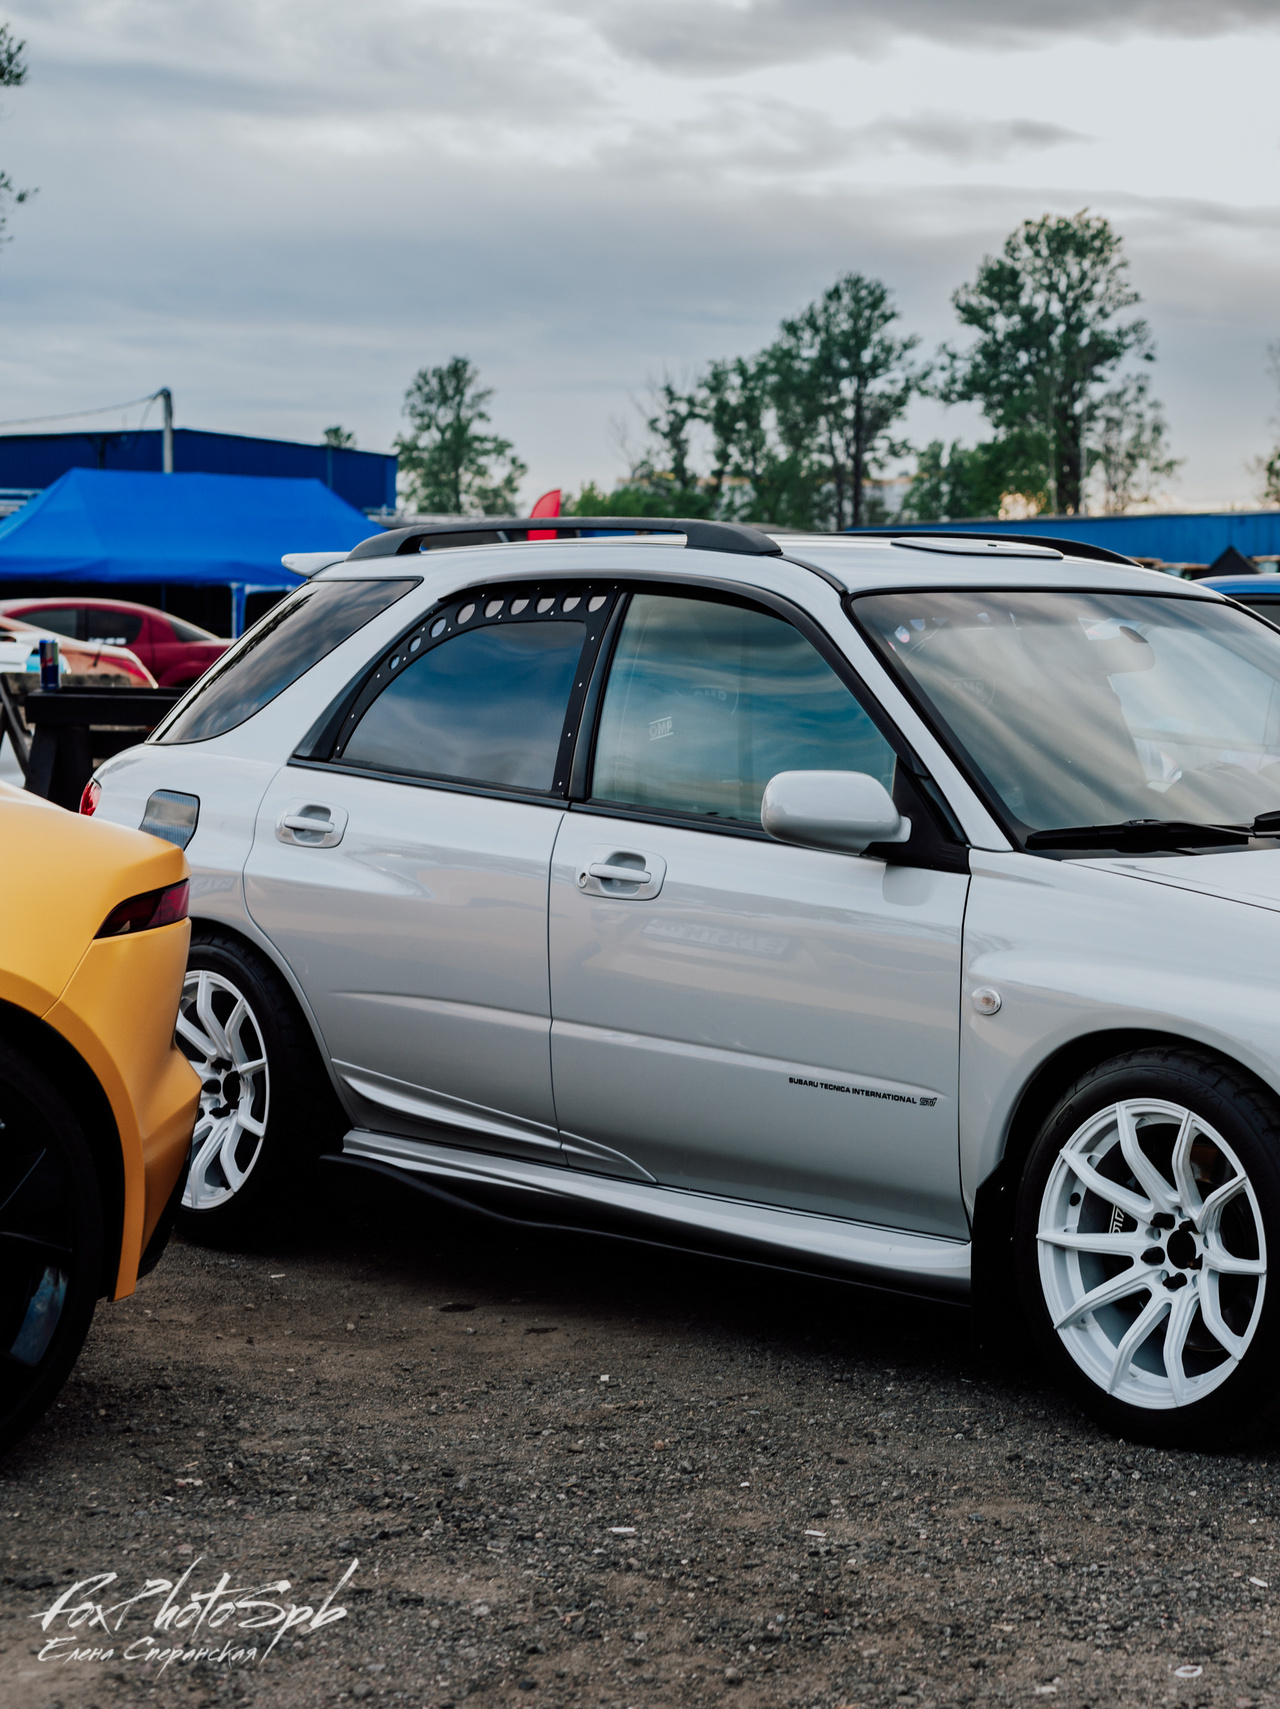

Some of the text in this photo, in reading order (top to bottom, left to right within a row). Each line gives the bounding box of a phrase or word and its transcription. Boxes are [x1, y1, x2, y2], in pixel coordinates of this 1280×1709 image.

[649, 719, 673, 738] OMP
[788, 1076, 819, 1088] SUBARU
[820, 1082, 851, 1094] TECNICA
[852, 1087, 917, 1104] INTERNATIONAL
